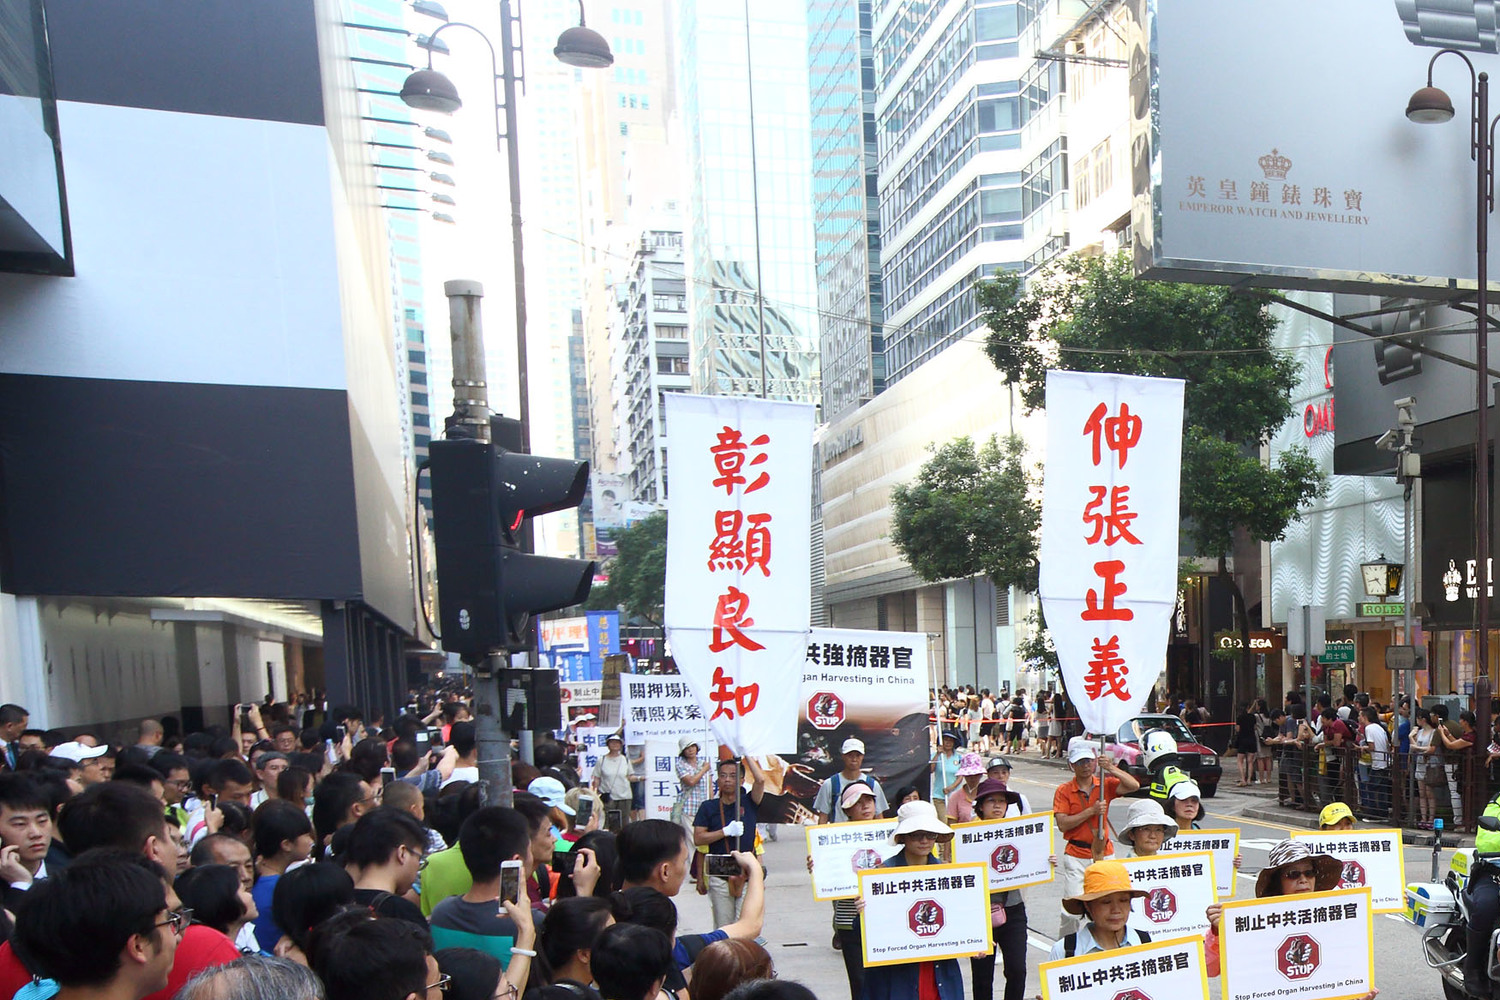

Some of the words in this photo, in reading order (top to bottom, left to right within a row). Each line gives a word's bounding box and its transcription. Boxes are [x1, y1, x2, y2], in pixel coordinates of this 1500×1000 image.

[1187, 175, 1363, 212] 英皇鐘錶珠寶
[1179, 201, 1233, 214] EMPEROR
[1237, 206, 1277, 218] WATCH
[1280, 209, 1303, 219] AND
[1305, 211, 1370, 225] JEWELLERY
[1080, 402, 1144, 702] 伸張正義
[707, 426, 772, 722] 彰顯良知
[1366, 604, 1405, 615] ROLEX
[821, 673, 873, 685] Harvesting
[876, 676, 884, 684] in
[888, 676, 915, 685] China
[631, 704, 706, 722] 薄熙來案
[962, 822, 1044, 844] 制止中共活摘器官
[1159, 839, 1230, 851] 止中共活摘器官
[872, 874, 976, 896] 制止中共活摘器官
[1235, 903, 1358, 933] 制止中共活摘器官
[1162, 926, 1191, 934] Harvesting
[928, 940, 959, 948] Harvesting
[1058, 952, 1190, 993] 制止中共活摘器官
[1252, 990, 1276, 1000] Forced
[1277, 987, 1297, 997] Organ
[1299, 982, 1335, 994] Harvesting
[1345, 977, 1364, 986] China
